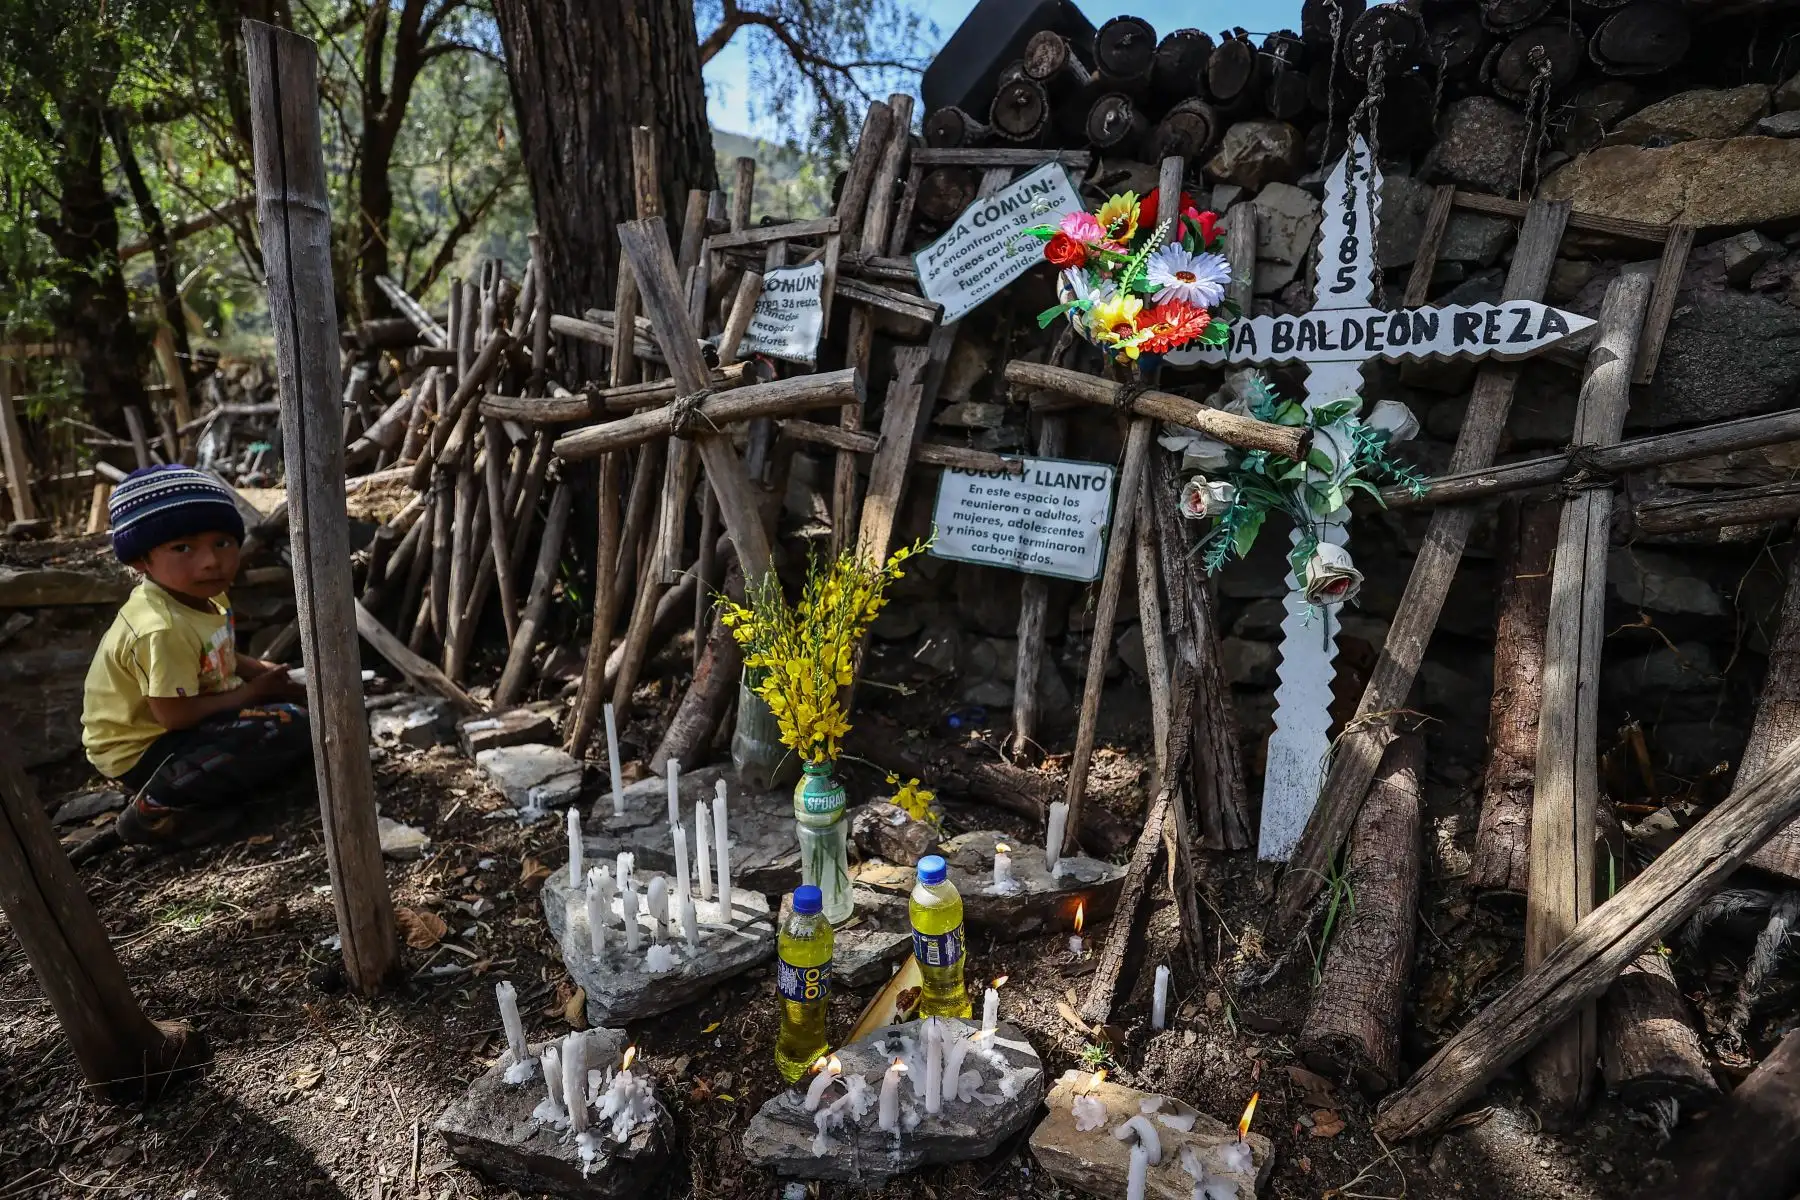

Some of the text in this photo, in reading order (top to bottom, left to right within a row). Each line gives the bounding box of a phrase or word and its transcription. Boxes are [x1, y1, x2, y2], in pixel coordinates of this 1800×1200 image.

[928, 178, 1056, 266] FOSA COMÚN:
[943, 224, 1011, 268] encontraron
[1012, 214, 1028, 226] 38
[1329, 184, 1359, 294] 1985
[953, 254, 985, 277] óseos
[958, 261, 998, 290] Fueron
[970, 282, 990, 296] con
[782, 298, 795, 309] 38
[1453, 307, 1570, 347] REZA
[1035, 470, 1106, 492] LLANTO
[969, 484, 1080, 508] En este espacio los
[961, 498, 1082, 524] reunieron a adultos,
[953, 511, 1085, 539] mujeres, adolescentes
[946, 524, 1086, 555] y niños que terminaron
[971, 542, 1054, 566] carbonizados.
